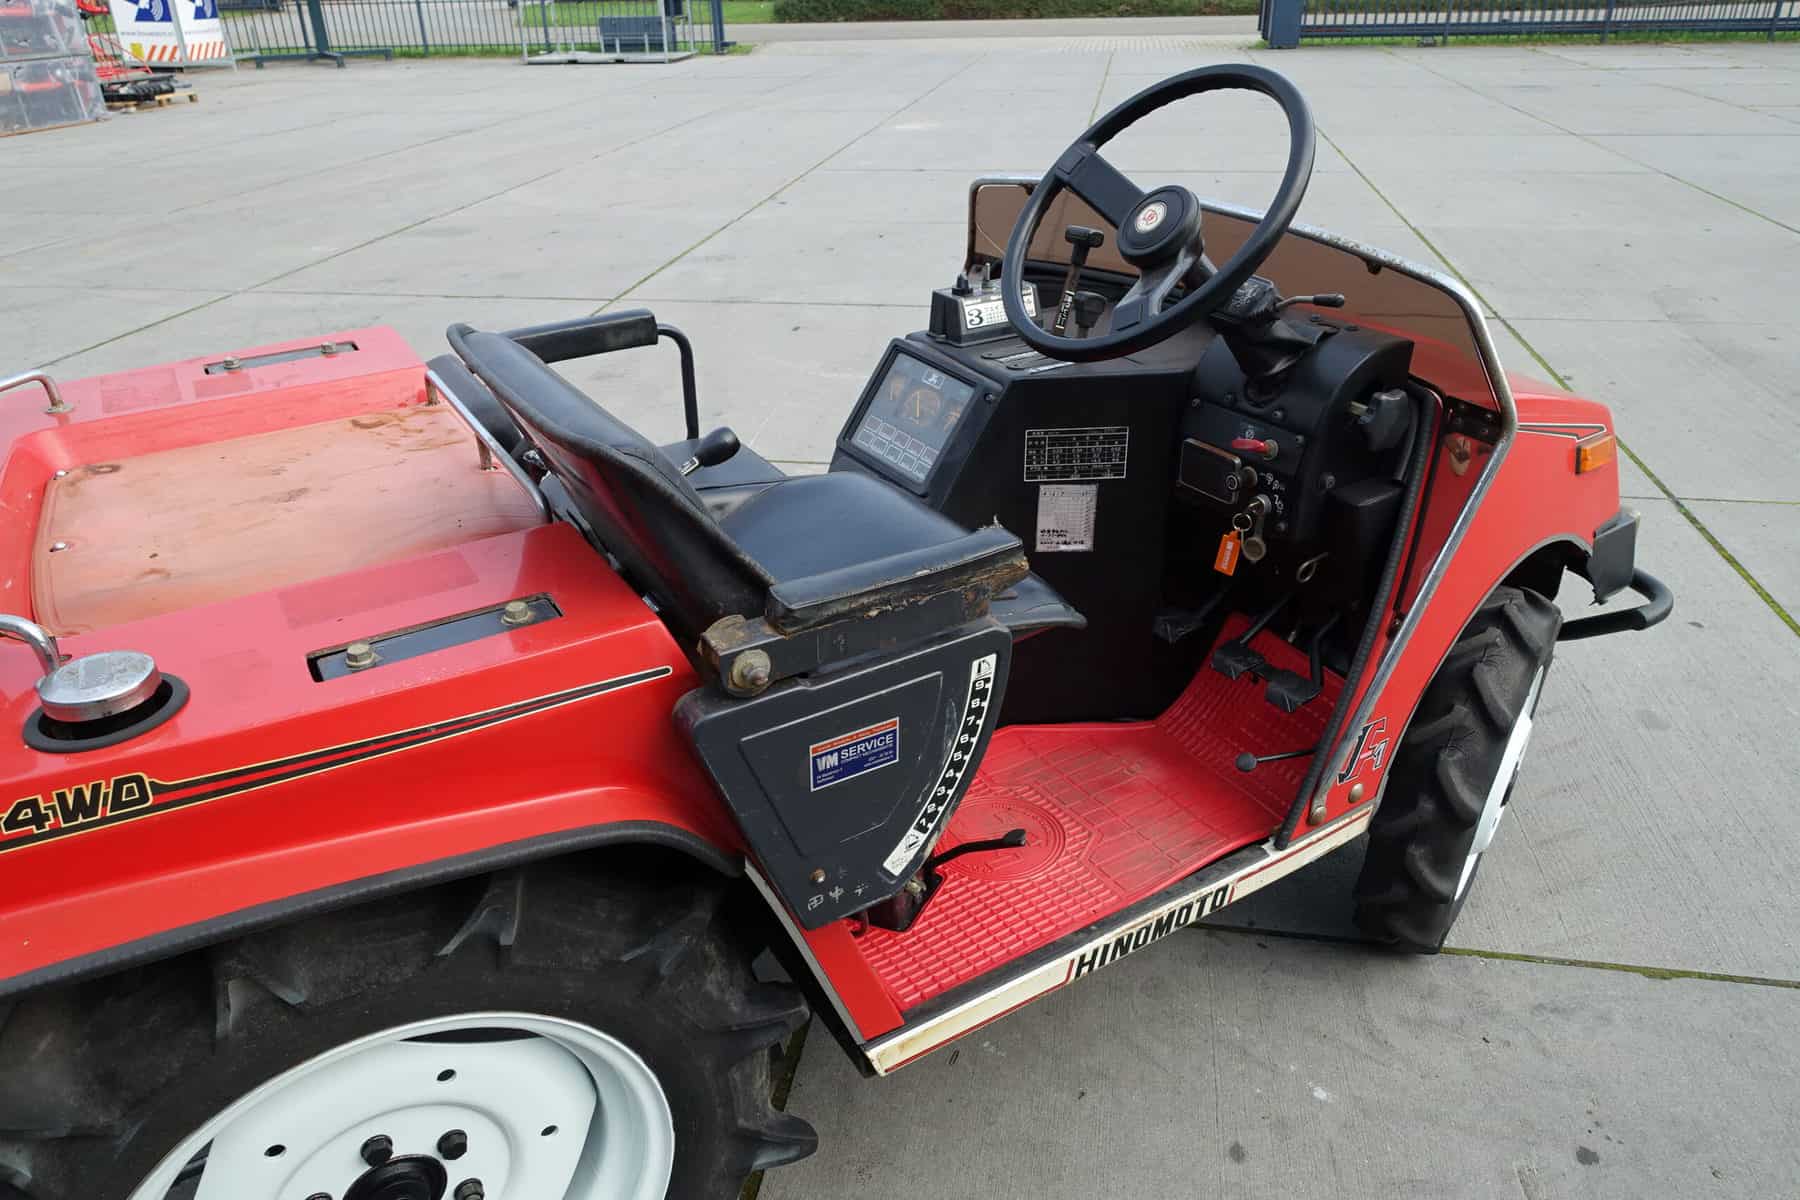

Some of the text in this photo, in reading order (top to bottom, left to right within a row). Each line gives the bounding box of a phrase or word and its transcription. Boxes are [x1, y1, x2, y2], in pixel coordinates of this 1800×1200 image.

[968, 308, 983, 326] 3
[975, 680, 984, 690] 9
[966, 715, 975, 726] 7
[840, 733, 894, 759] SERVICE
[953, 751, 962, 761] 5
[945, 768, 954, 778] 4
[936, 786, 946, 796] 3
[1, 772, 152, 833] 4WD
[919, 817, 926, 826] 1
[1074, 884, 1229, 979] HINOMOTO
